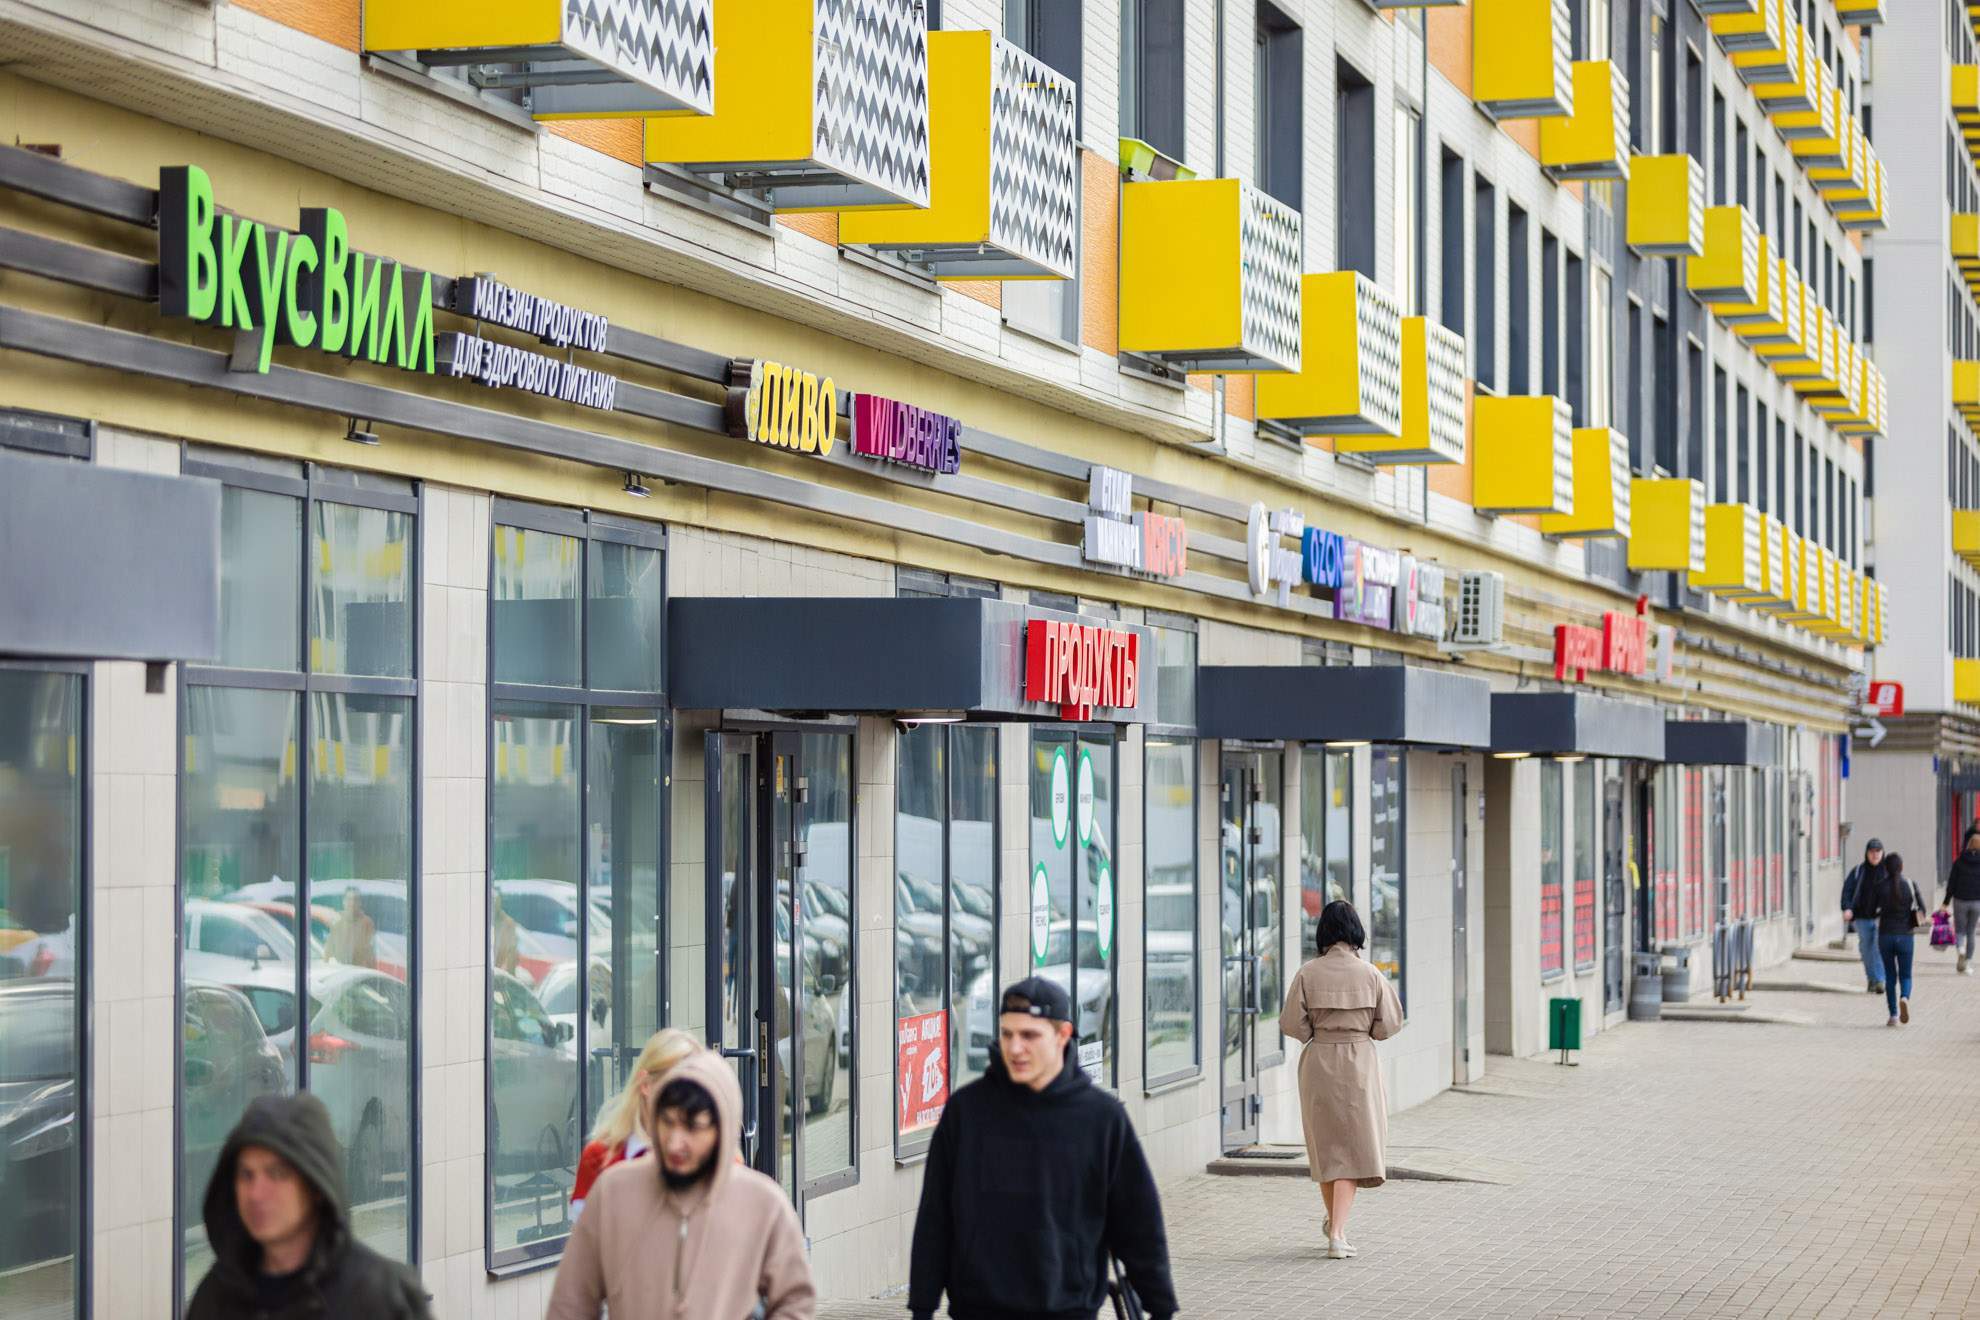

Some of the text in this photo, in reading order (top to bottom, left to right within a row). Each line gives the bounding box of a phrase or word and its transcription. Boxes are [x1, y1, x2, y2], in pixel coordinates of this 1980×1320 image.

[473, 278, 608, 353] МАГАЗИН ПРОДУКТОВ
[452, 332, 617, 411] ДЛЯ ЗДОРОВОГО ПИТАНИЯ
[758, 360, 837, 457] ПИВО
[870, 394, 962, 476] WILDBERRIES
[1310, 527, 1345, 588] OZON
[1044, 620, 1140, 721] ПРОДУКТЫ
